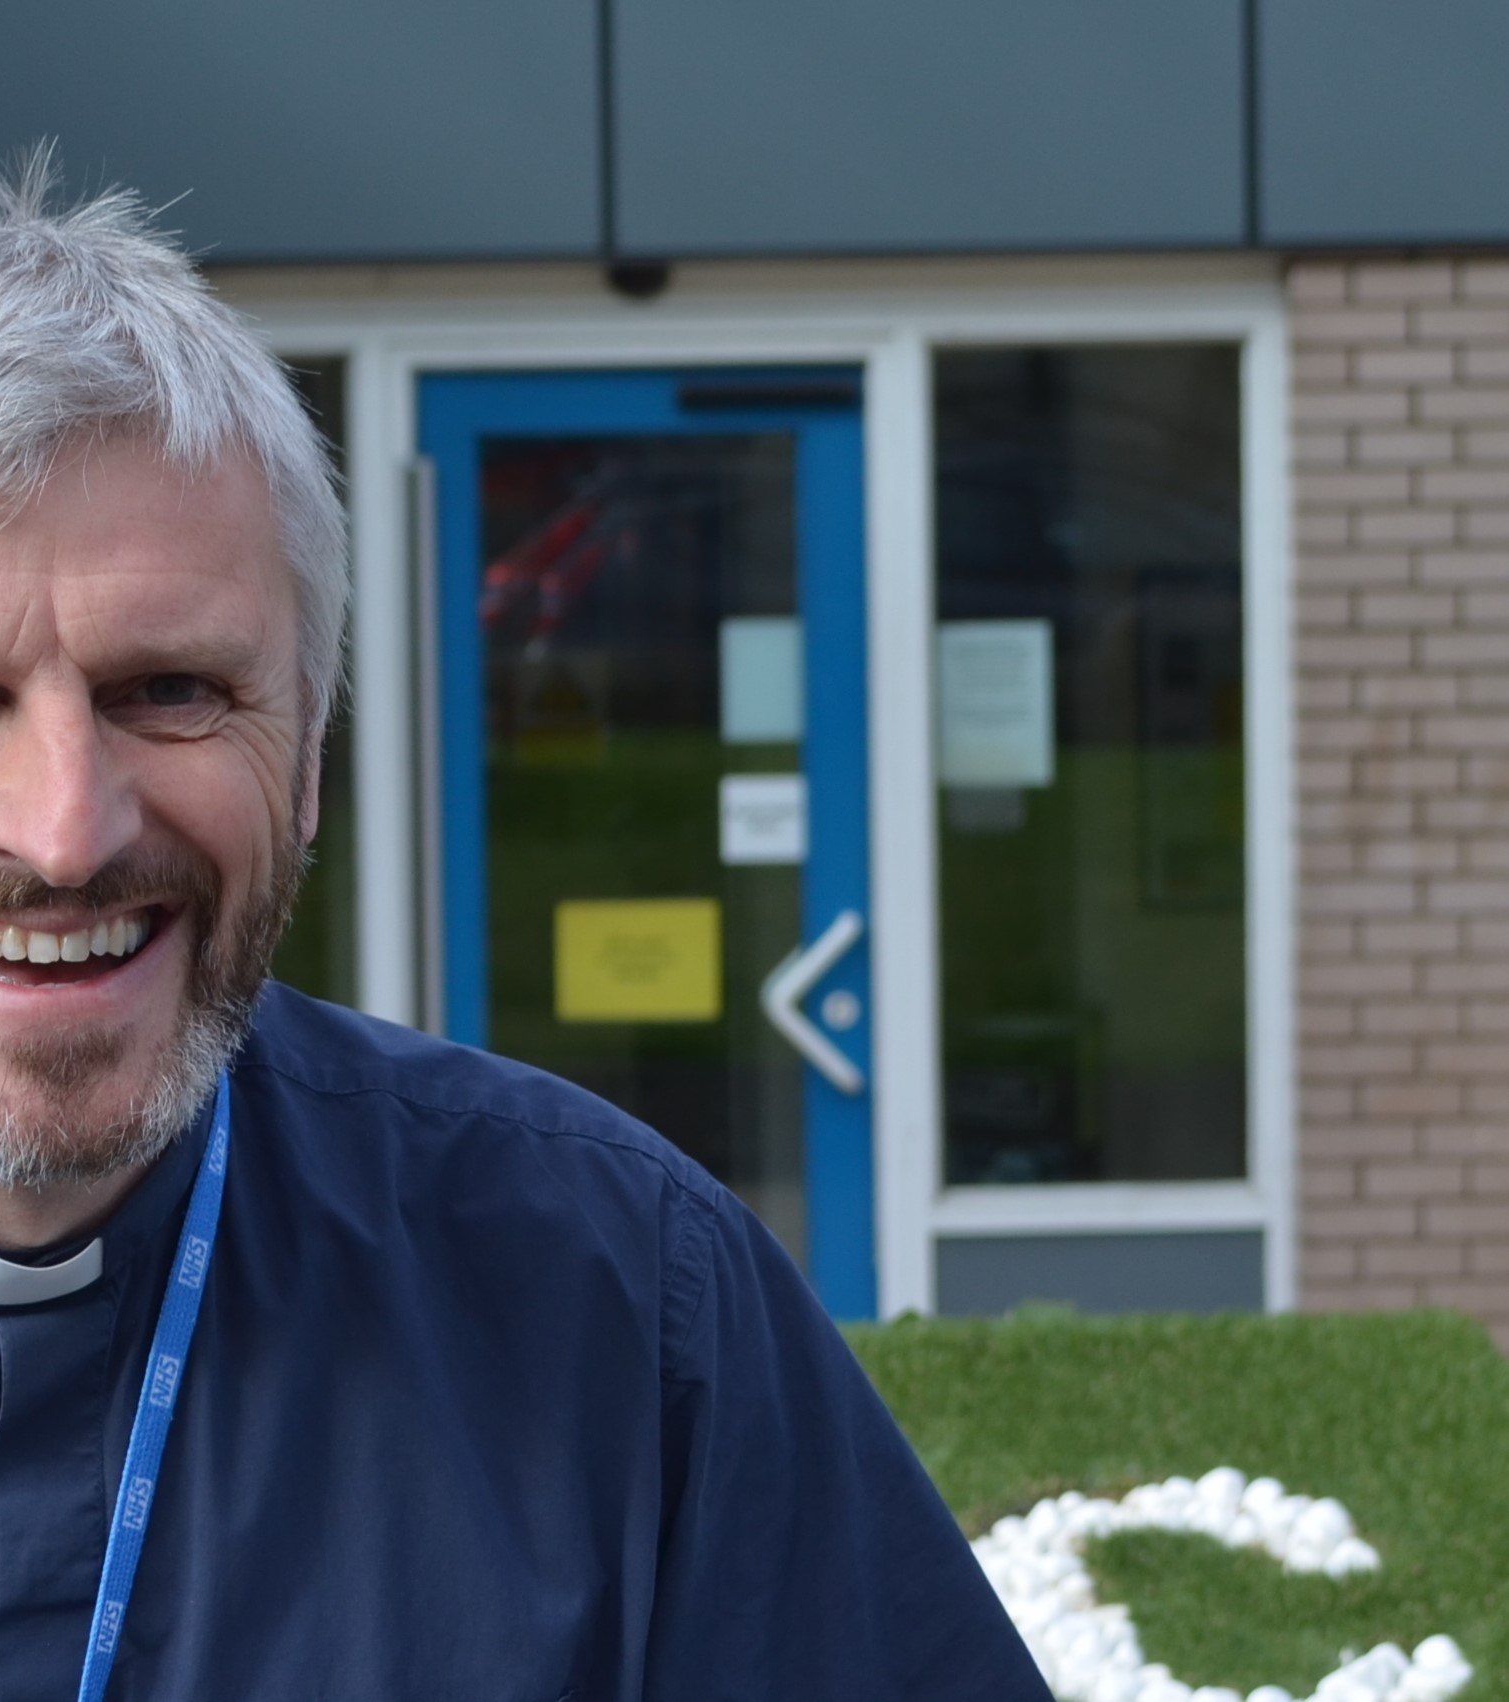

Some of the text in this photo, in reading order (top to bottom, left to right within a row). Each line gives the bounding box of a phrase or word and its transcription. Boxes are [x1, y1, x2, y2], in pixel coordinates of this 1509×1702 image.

[179, 1237, 209, 1288] NHS
[150, 1355, 180, 1407] NHS
[124, 1477, 153, 1531] NHS
[97, 1600, 123, 1654] NHS
